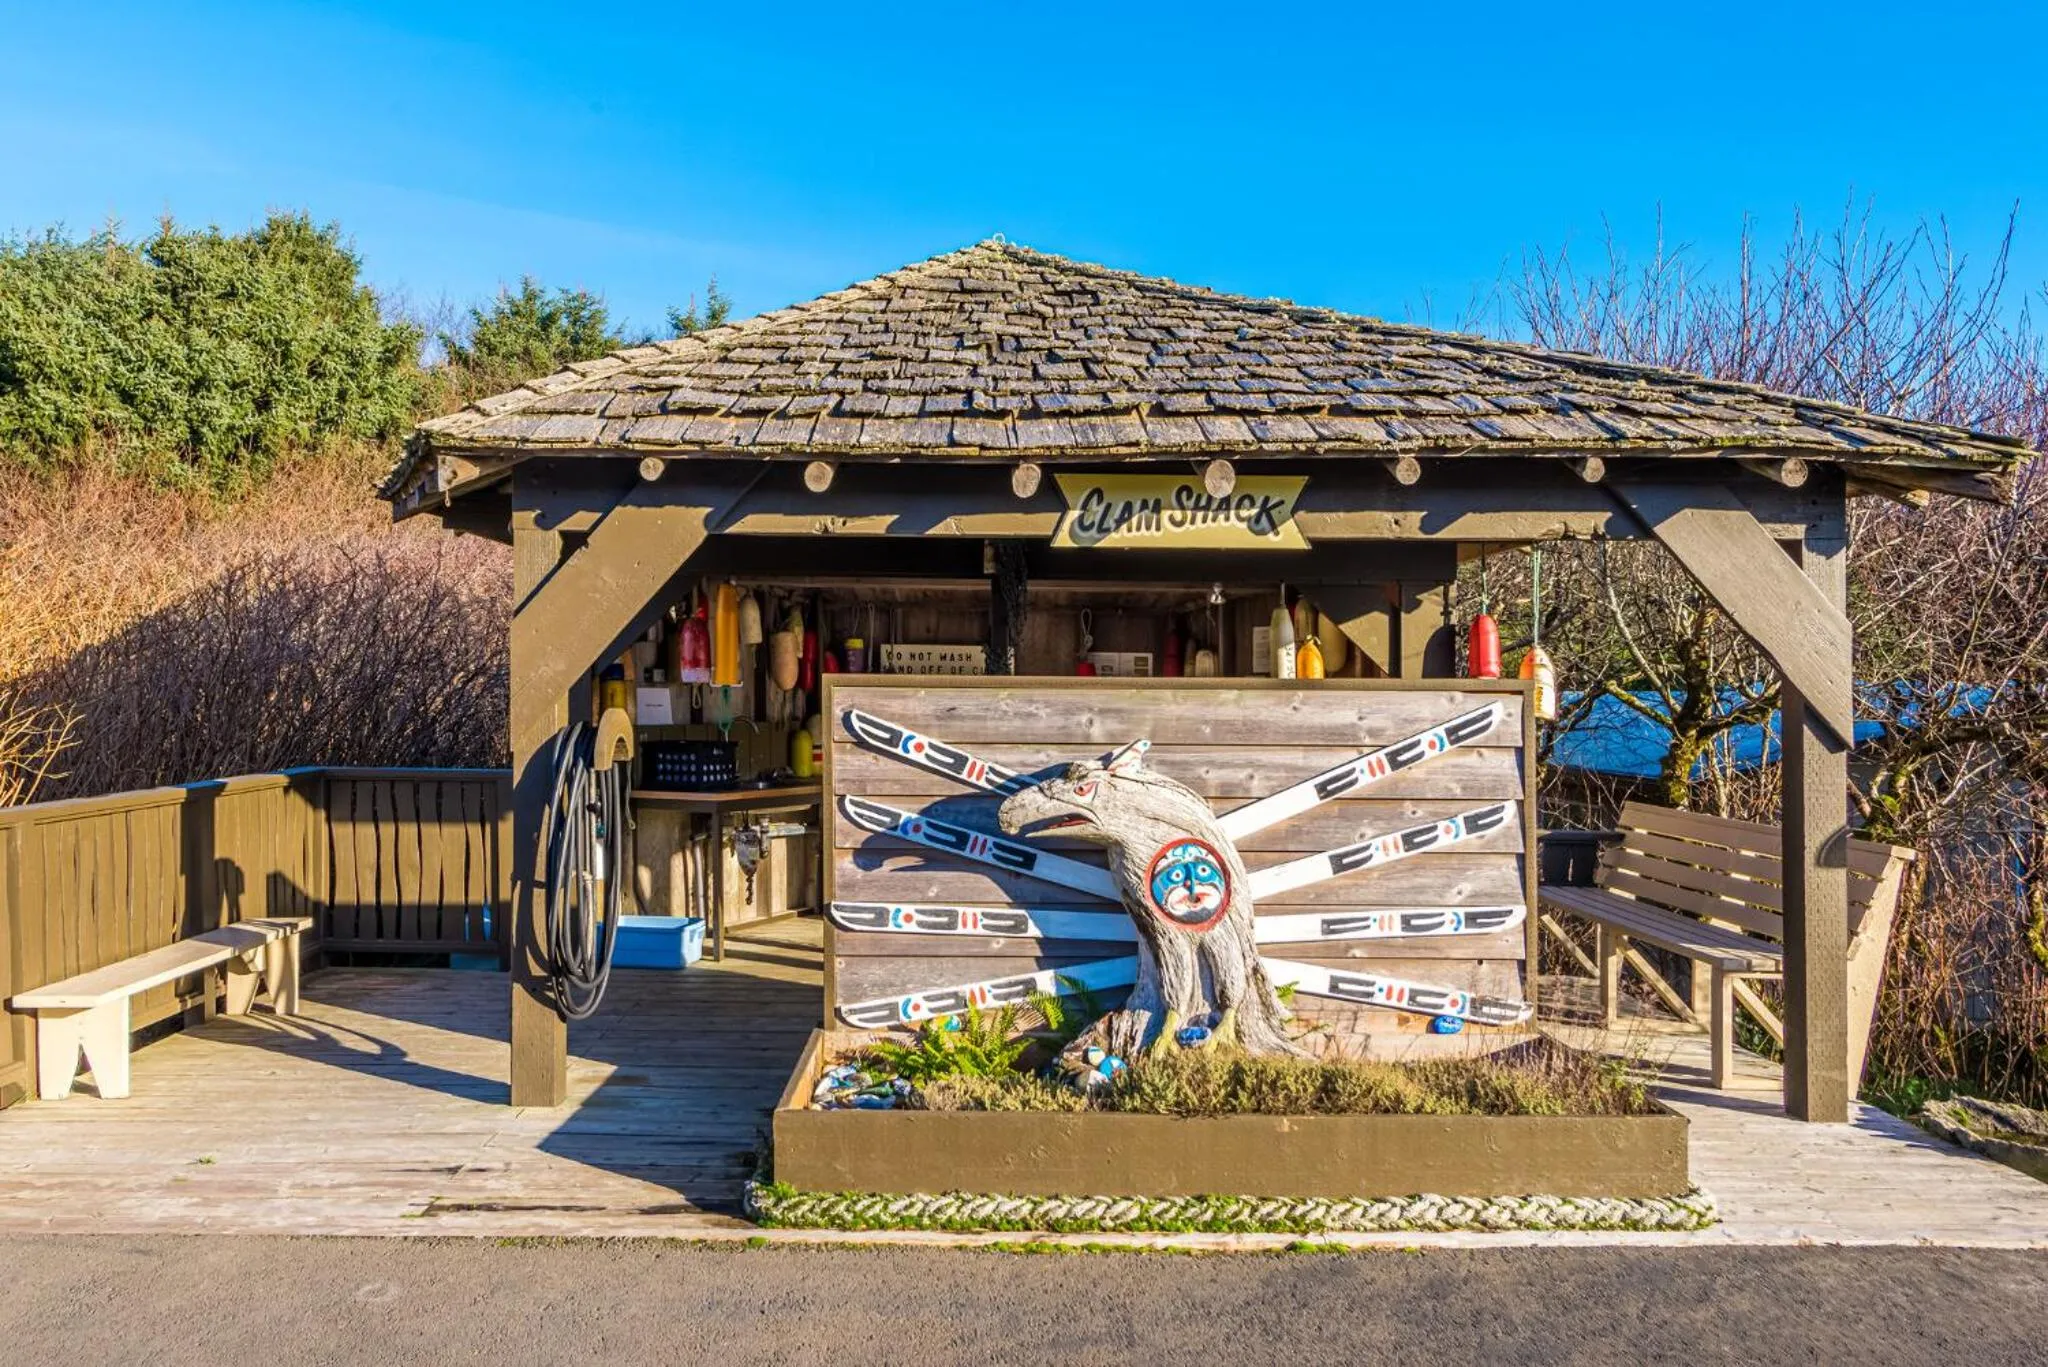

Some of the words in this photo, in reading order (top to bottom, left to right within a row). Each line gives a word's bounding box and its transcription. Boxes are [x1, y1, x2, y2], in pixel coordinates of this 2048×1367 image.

[1076, 487, 1162, 532] CLAM
[1168, 484, 1285, 537] SHACK
[910, 651, 932, 661] NOT
[940, 652, 972, 662] WASH
